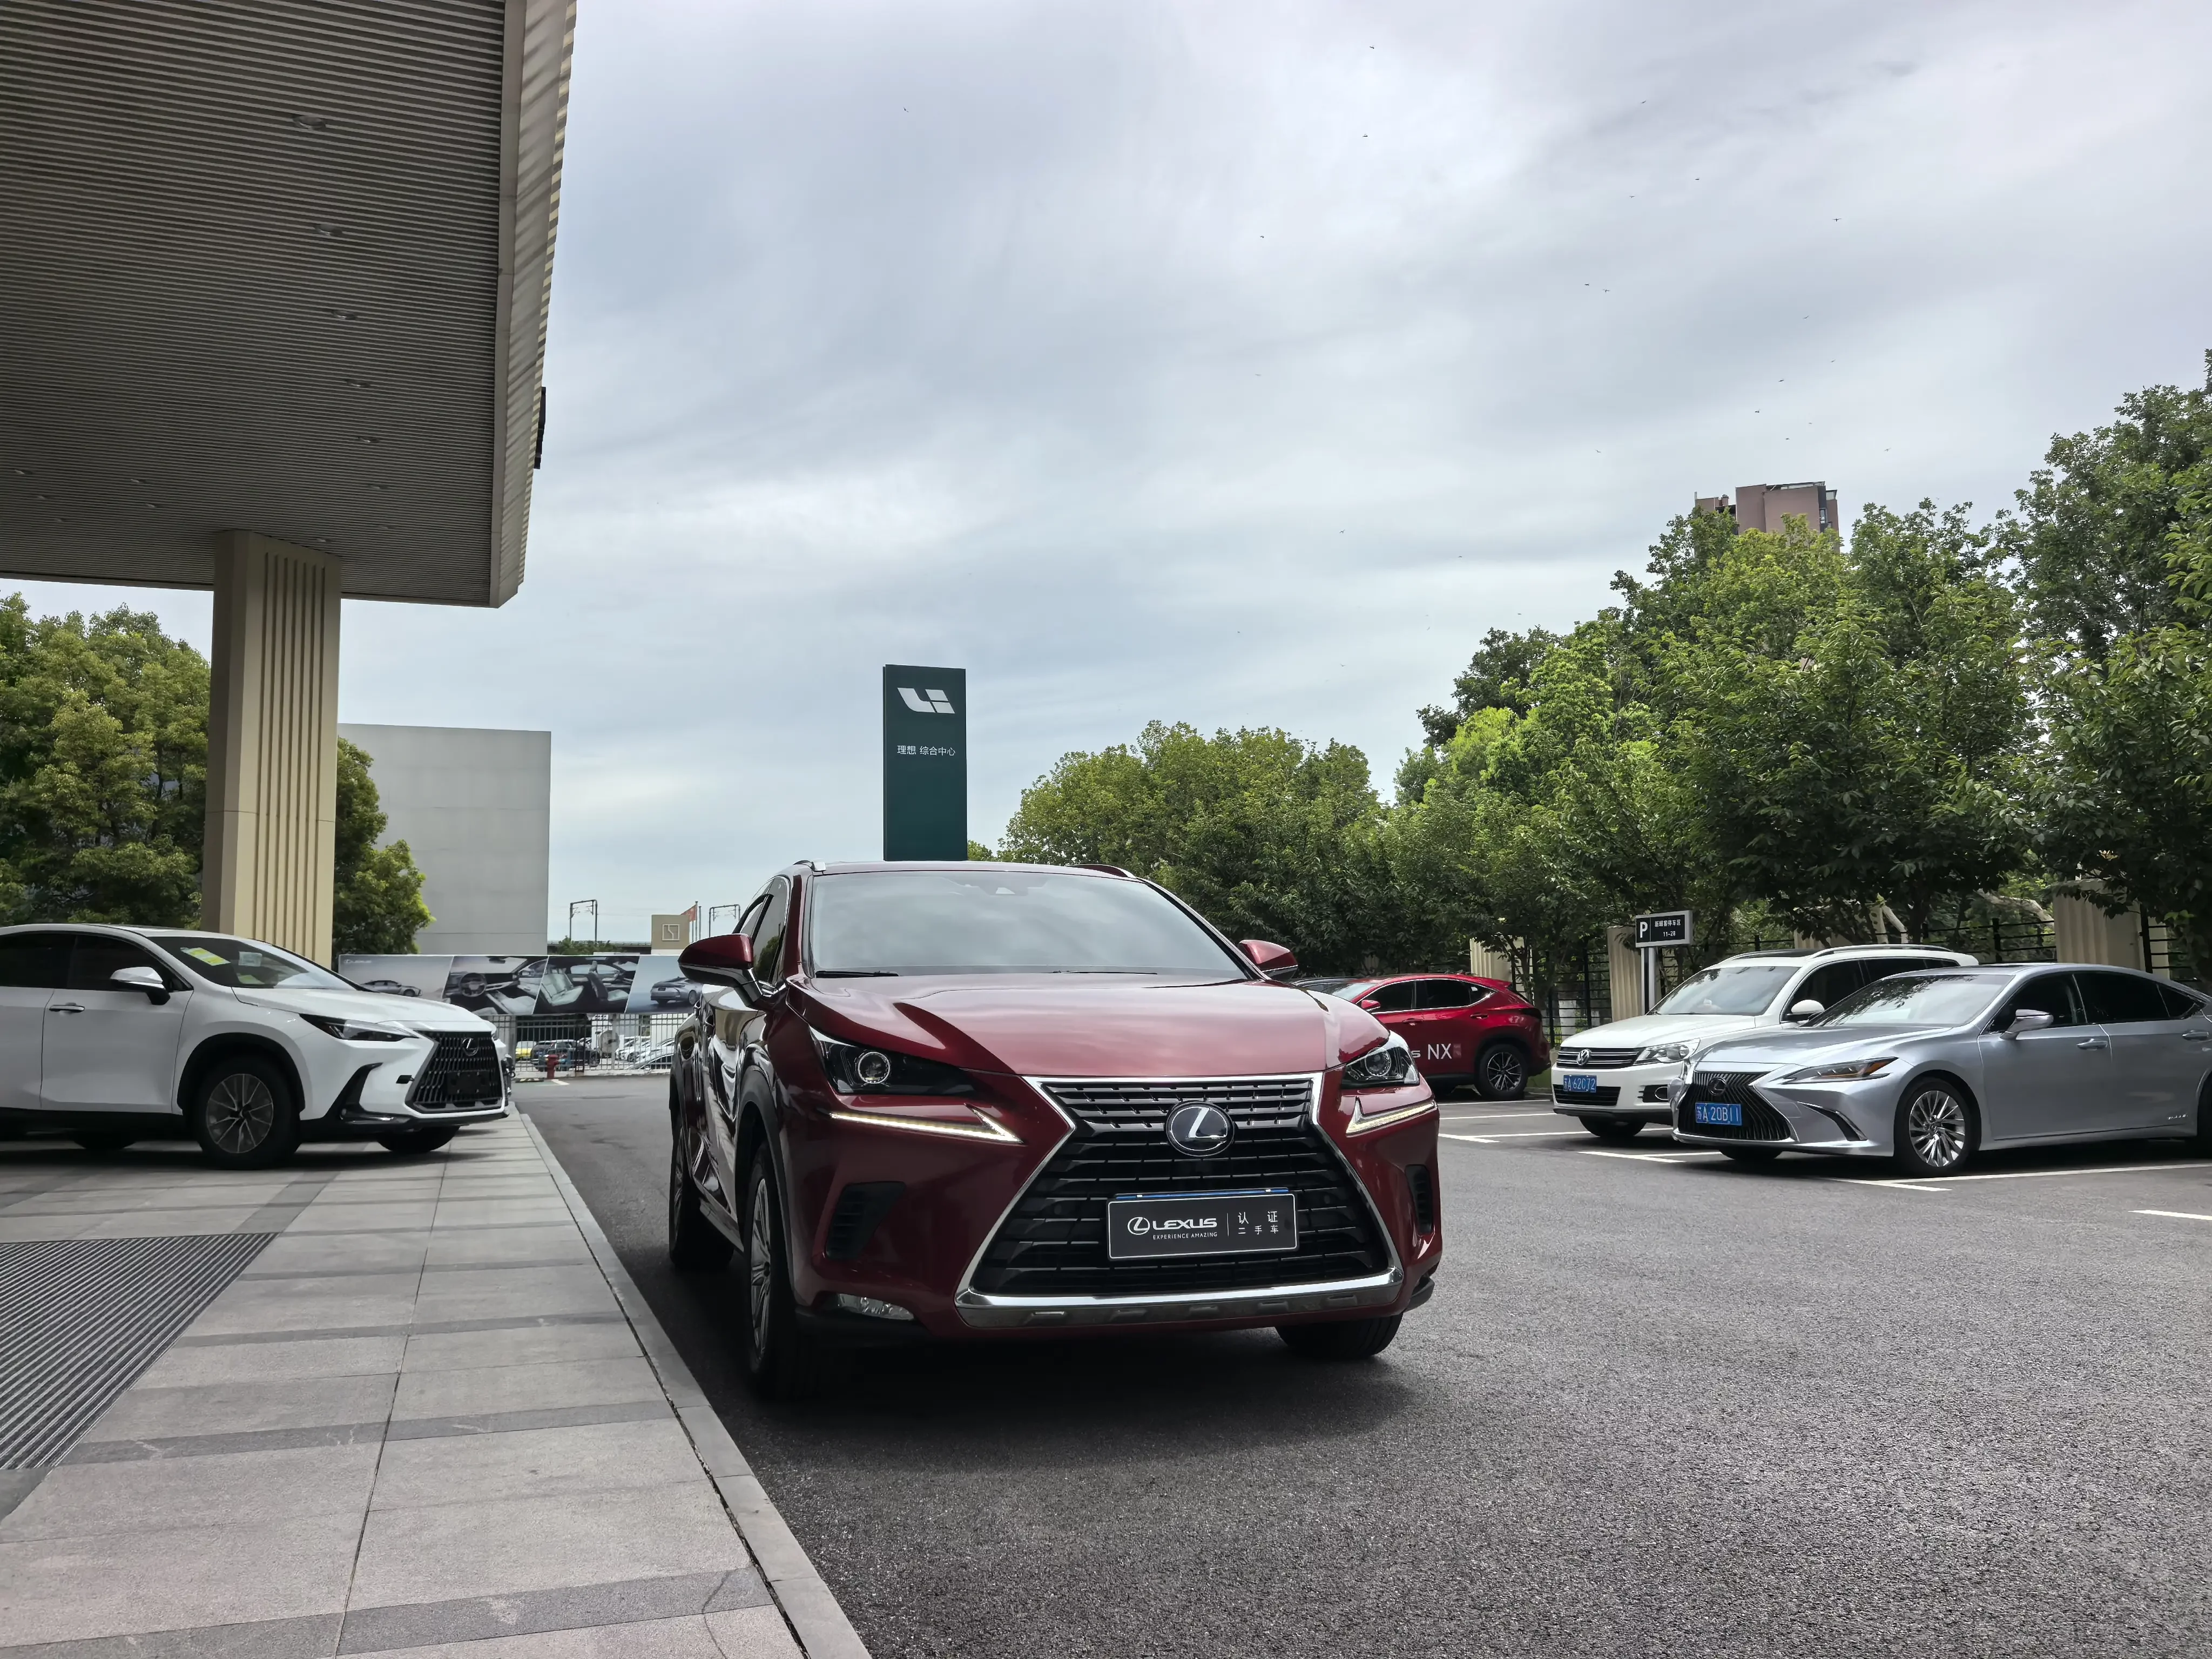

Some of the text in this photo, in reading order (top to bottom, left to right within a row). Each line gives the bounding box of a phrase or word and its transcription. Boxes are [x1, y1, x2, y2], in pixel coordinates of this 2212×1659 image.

[896, 745, 956, 756] 理想 综合中心
[1640, 921, 1648, 938] P
[1428, 1043, 1452, 1060] NX
[1238, 1211, 1278, 1224] 认证
[1152, 1218, 1218, 1231] LEXUS
[1238, 1224, 1279, 1235] 二手车
